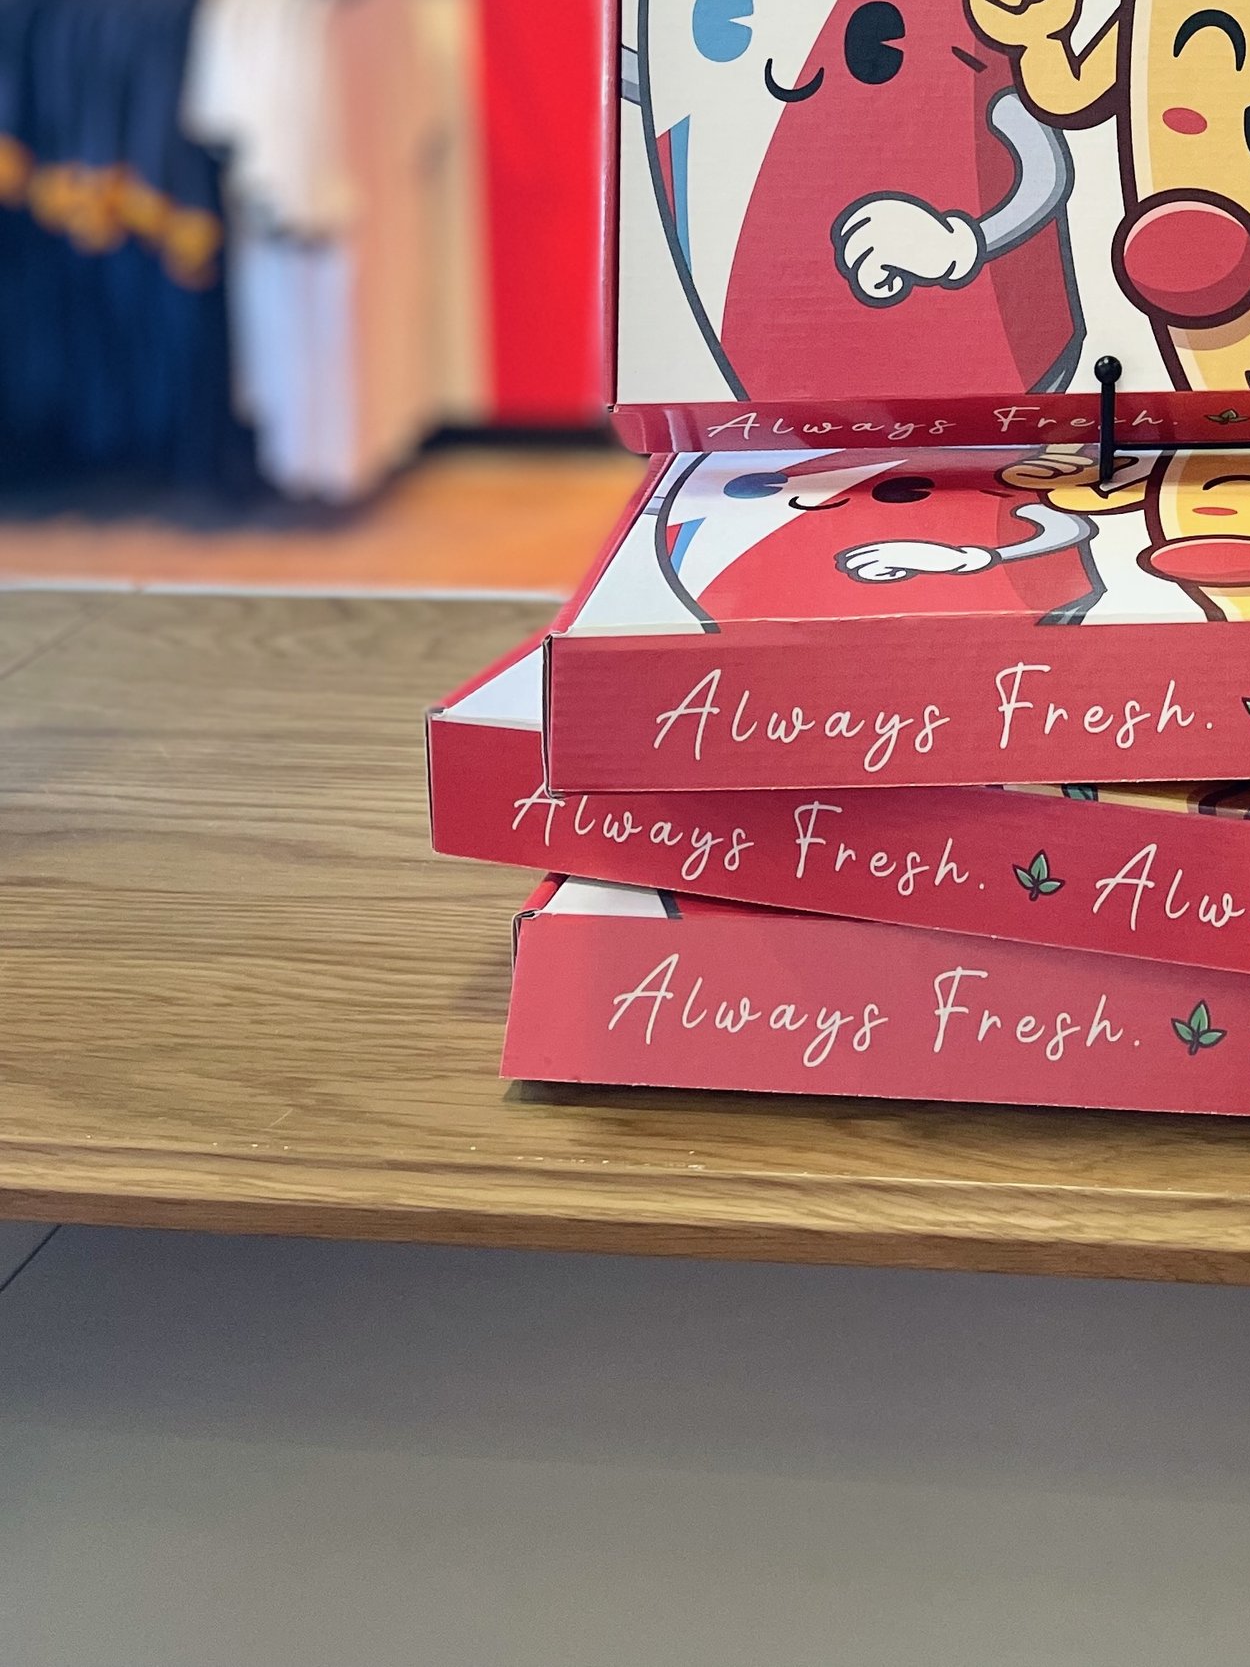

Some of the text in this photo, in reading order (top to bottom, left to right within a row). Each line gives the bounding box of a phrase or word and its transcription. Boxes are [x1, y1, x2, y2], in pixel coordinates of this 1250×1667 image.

[706, 411, 957, 442] Always
[993, 406, 1179, 432] Freh.
[653, 668, 951, 774] Always
[994, 661, 1215, 750] Fresh.
[511, 781, 755, 882] Always
[792, 800, 987, 897] Fresh.
[607, 952, 889, 1069] Always
[932, 965, 1142, 1062] Fresh.
